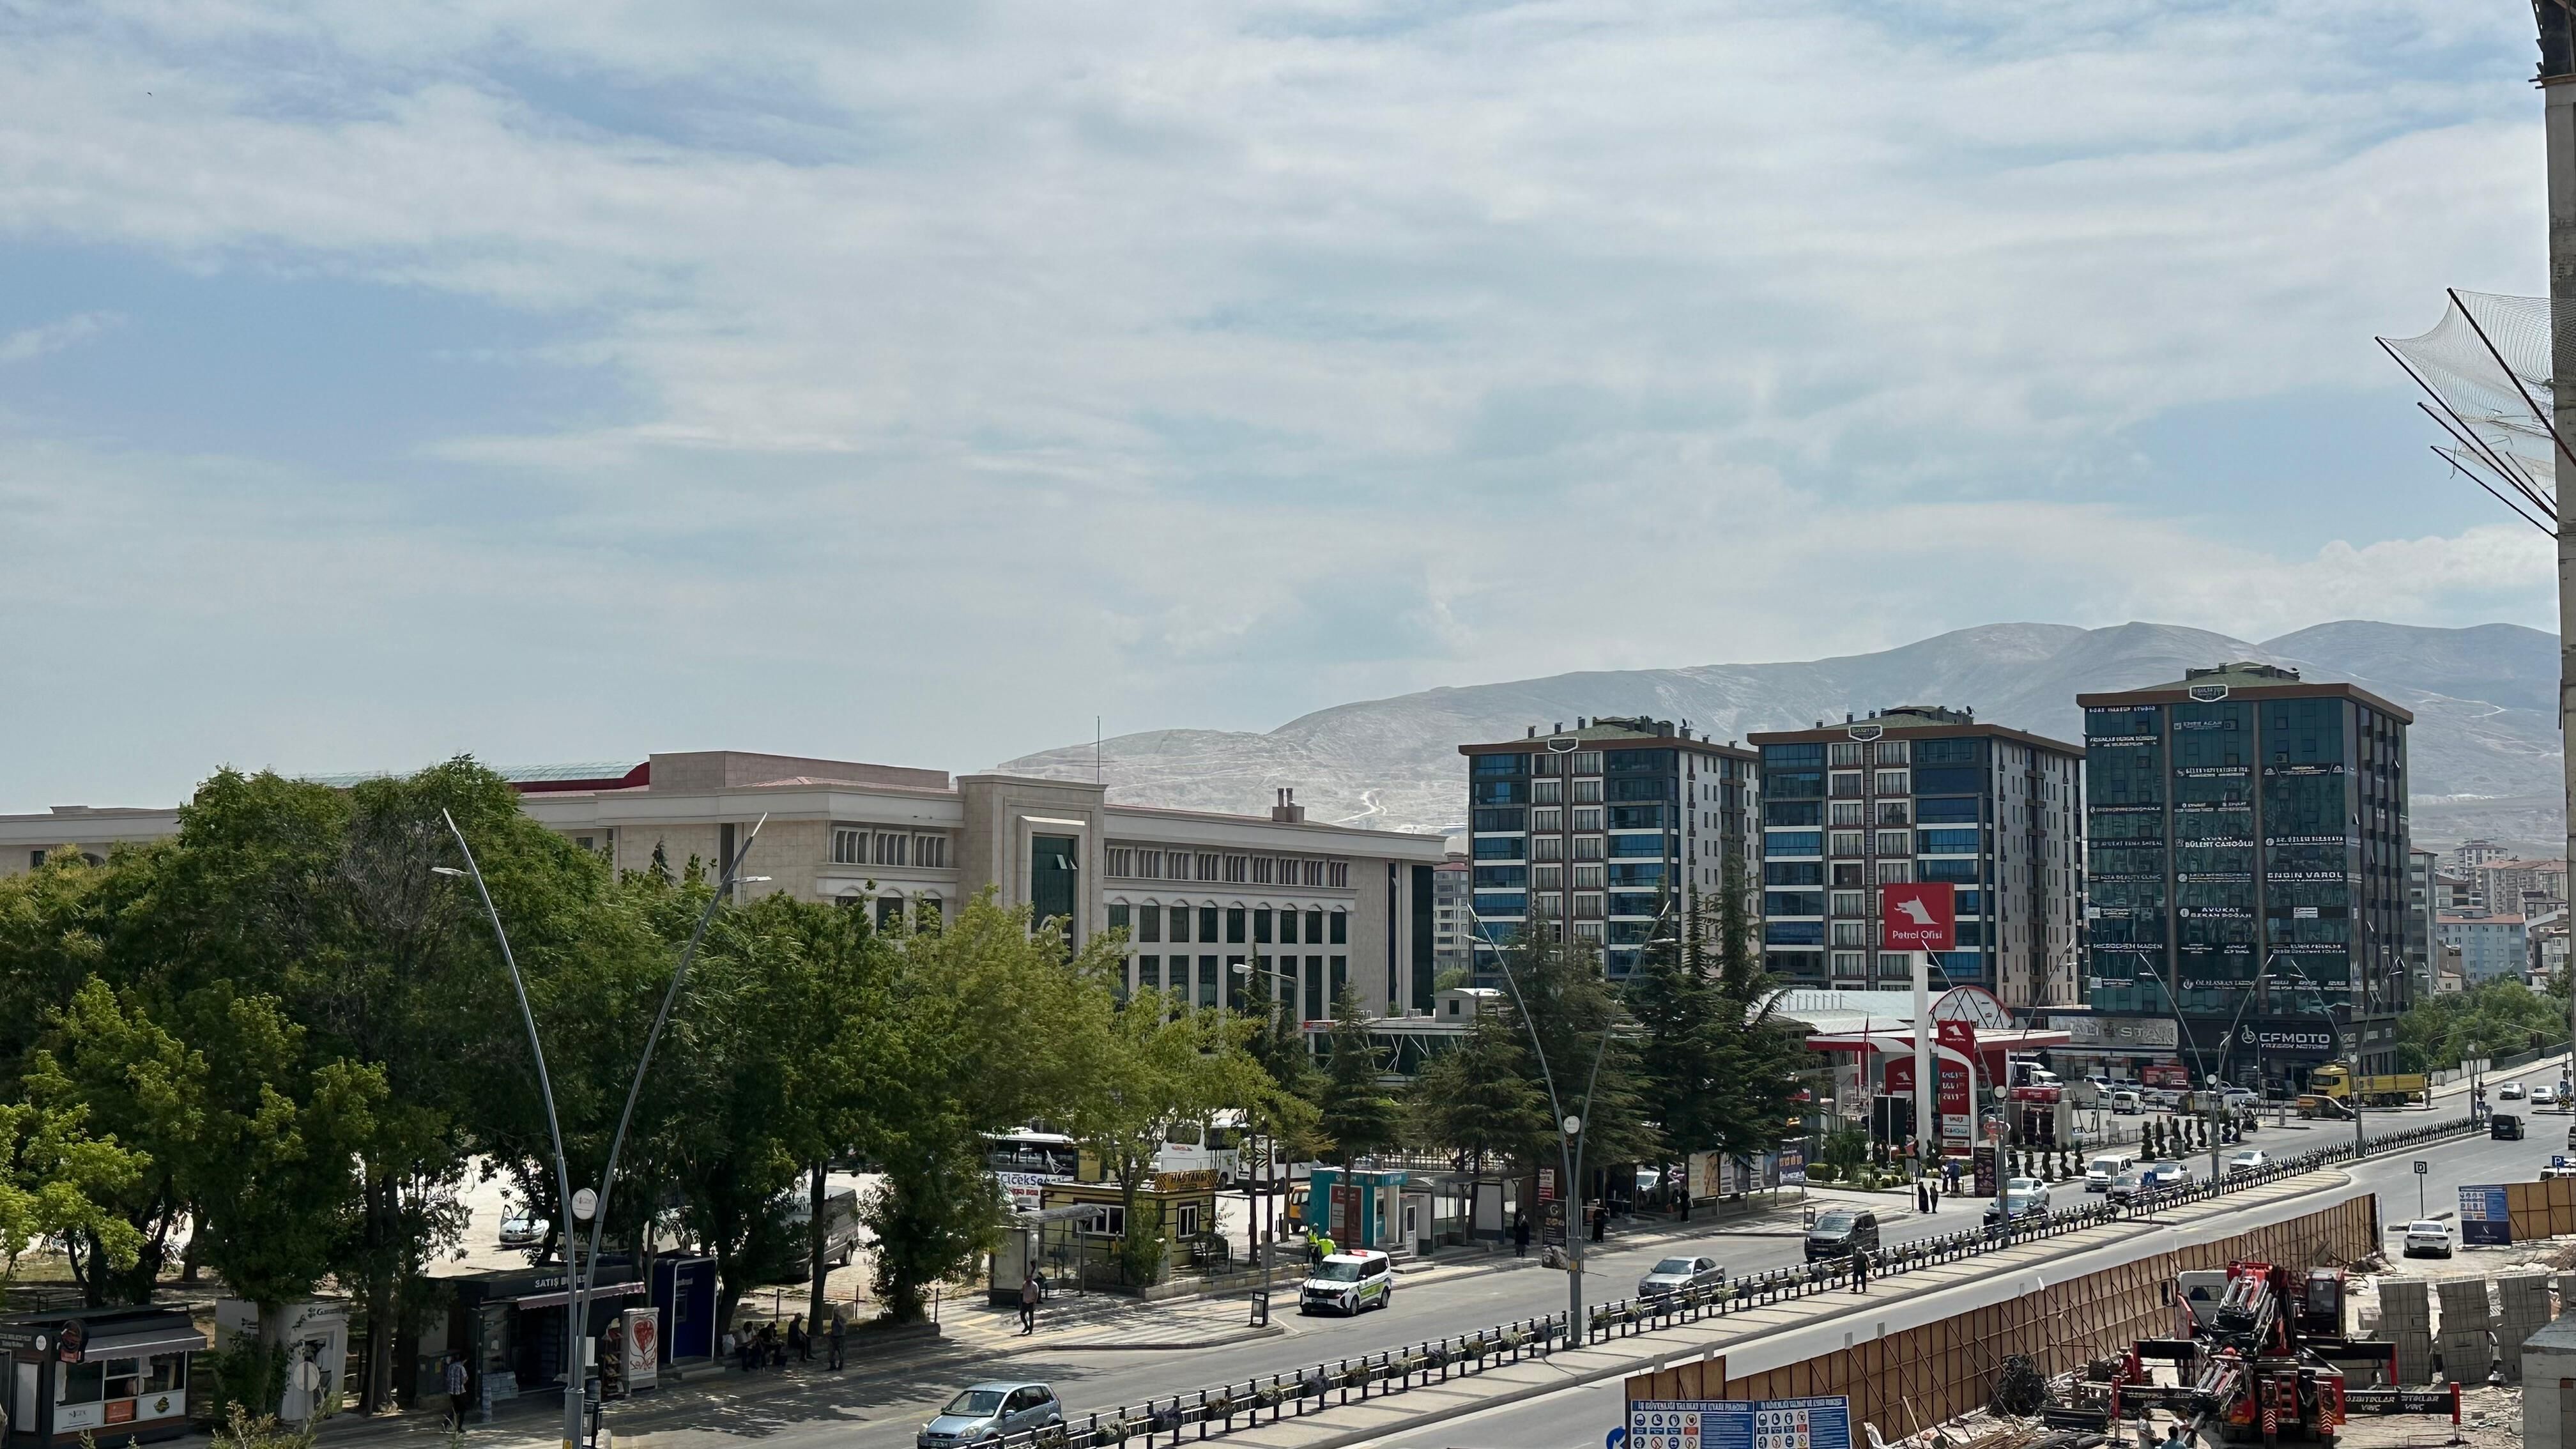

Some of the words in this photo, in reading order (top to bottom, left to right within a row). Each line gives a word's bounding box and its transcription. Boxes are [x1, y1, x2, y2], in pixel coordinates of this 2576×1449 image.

[1892, 930, 1919, 939] Petrol
[1921, 930, 1942, 939] Ofisi
[2259, 1032, 2330, 1043] CFMOTO
[2554, 1157, 2561, 1166] P
[535, 1278, 558, 1287] SATIŞ
